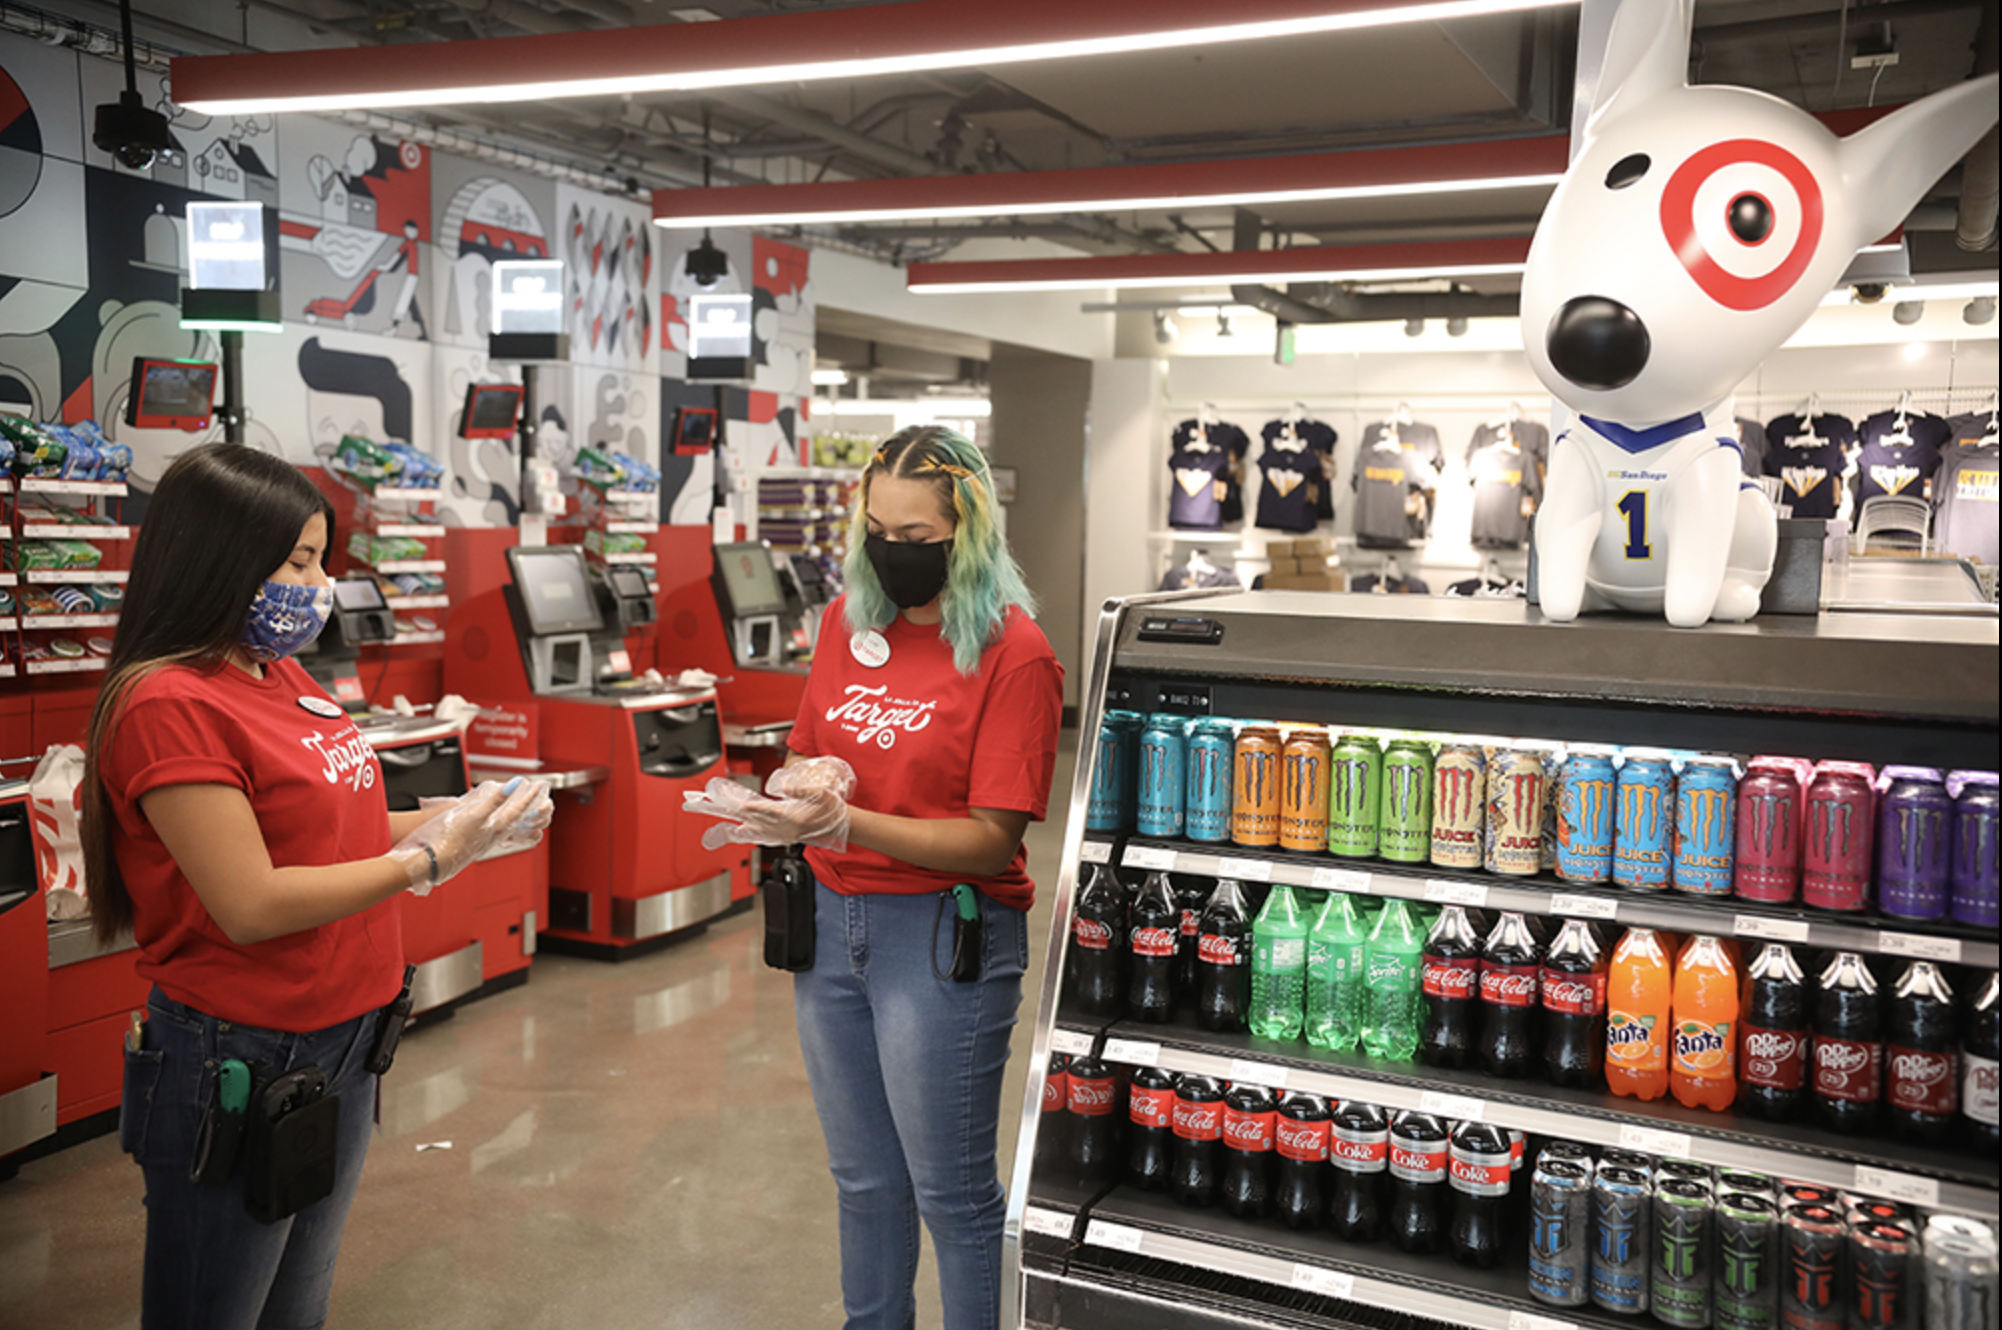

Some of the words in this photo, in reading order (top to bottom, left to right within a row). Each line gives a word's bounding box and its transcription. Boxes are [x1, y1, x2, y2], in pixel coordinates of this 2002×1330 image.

[1614, 488, 1653, 561] 1
[825, 684, 937, 743] Target
[1433, 827, 1476, 843] JUICE
[1501, 835, 1541, 849] JUIC
[1615, 847, 1663, 863] JUICE
[1680, 853, 1731, 869] JUICE
[1608, 1022, 1649, 1045] anta
[1336, 1139, 1373, 1160] Coke
[1393, 1148, 1430, 1170] Coke
[1452, 1160, 1490, 1182] Coke
